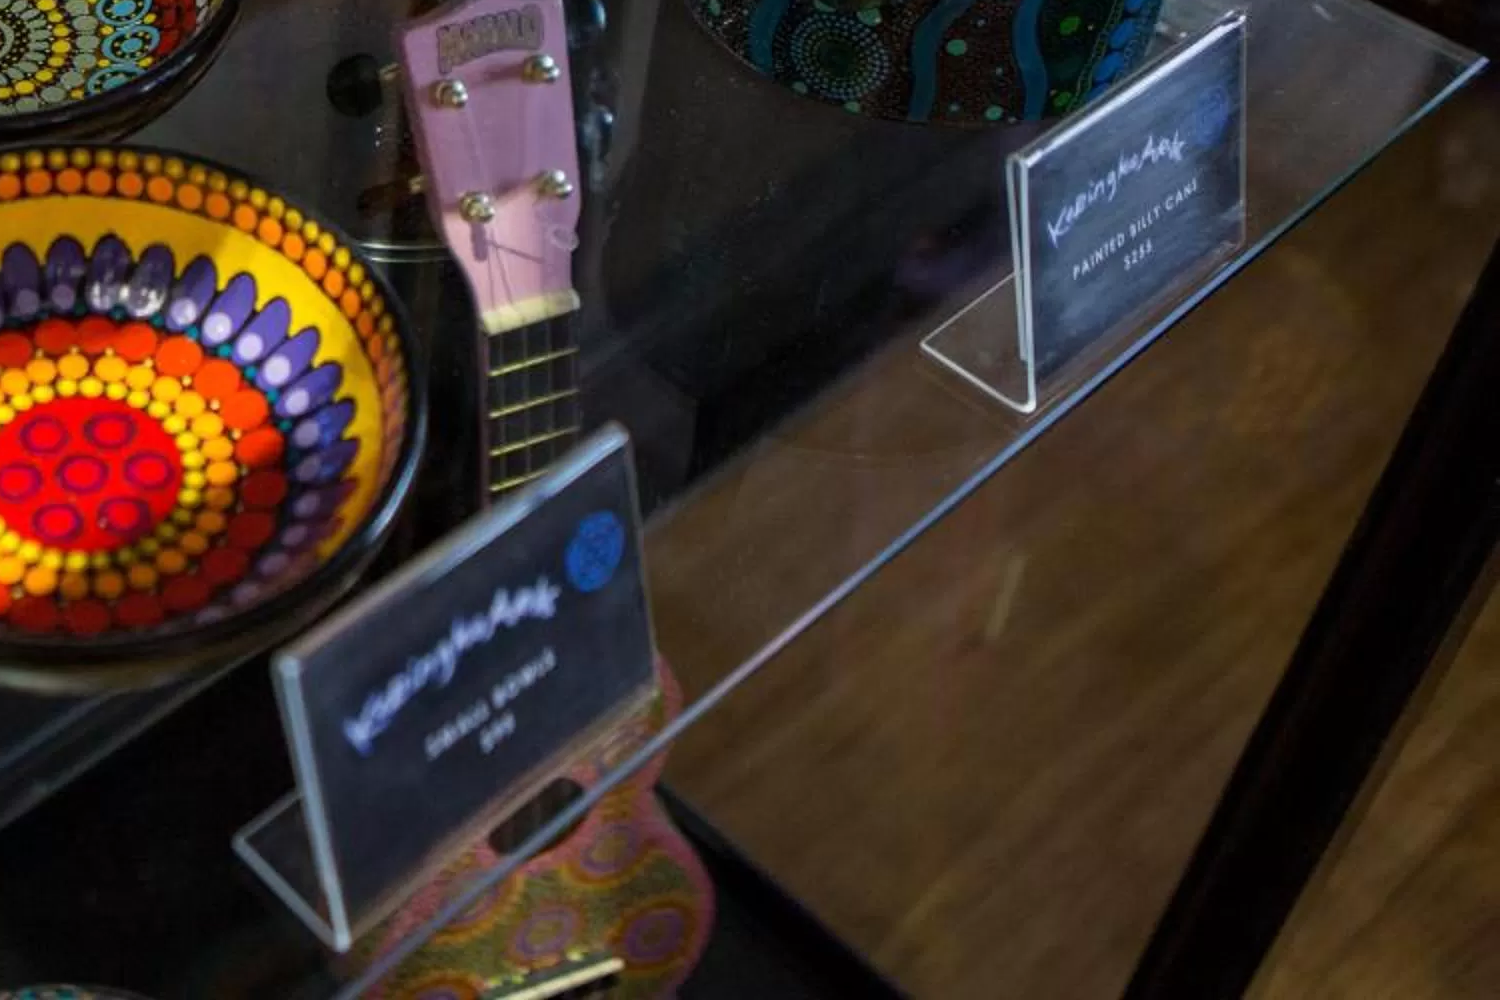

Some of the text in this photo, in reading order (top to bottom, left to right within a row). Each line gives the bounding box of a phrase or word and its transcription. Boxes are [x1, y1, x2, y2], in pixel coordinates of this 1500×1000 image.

[1072, 177, 1198, 281] PAINTED BILLY CANS
